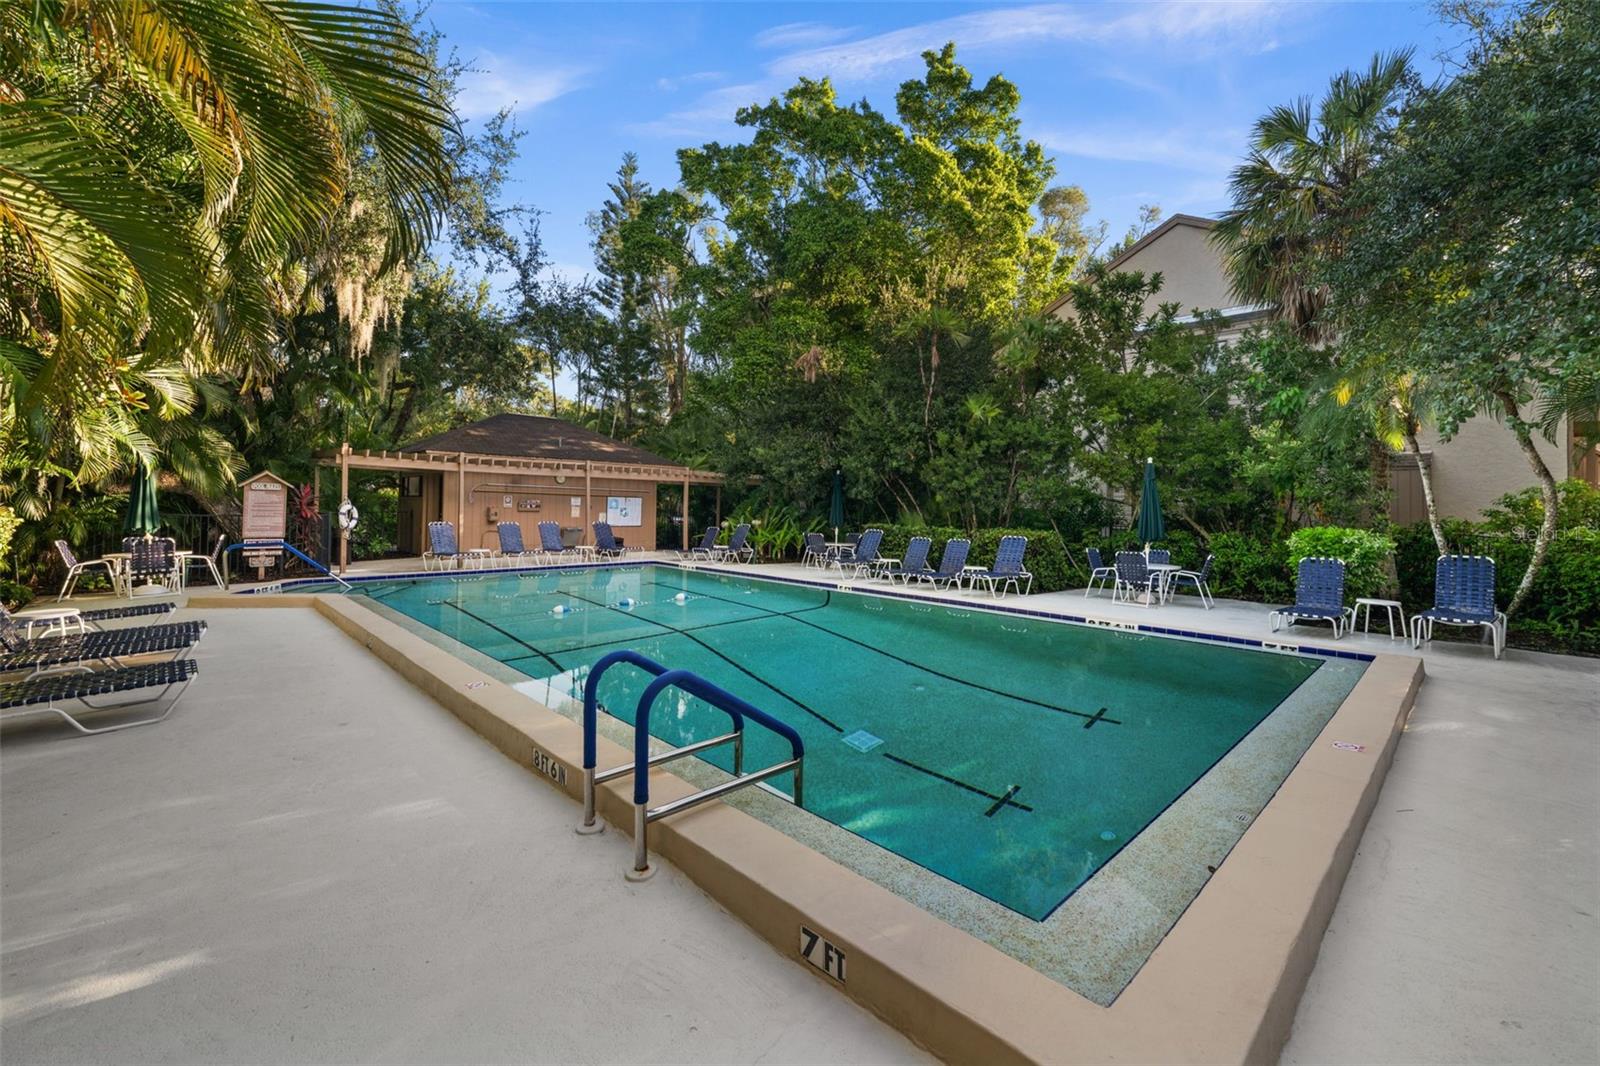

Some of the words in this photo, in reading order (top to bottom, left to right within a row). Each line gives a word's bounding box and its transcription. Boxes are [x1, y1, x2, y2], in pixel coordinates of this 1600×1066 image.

[534, 750, 540, 767] 8
[541, 754, 549, 774] FT
[550, 762, 557, 779] 6
[559, 765, 566, 785] IN
[802, 926, 819, 958] 7
[824, 941, 846, 980] FT
